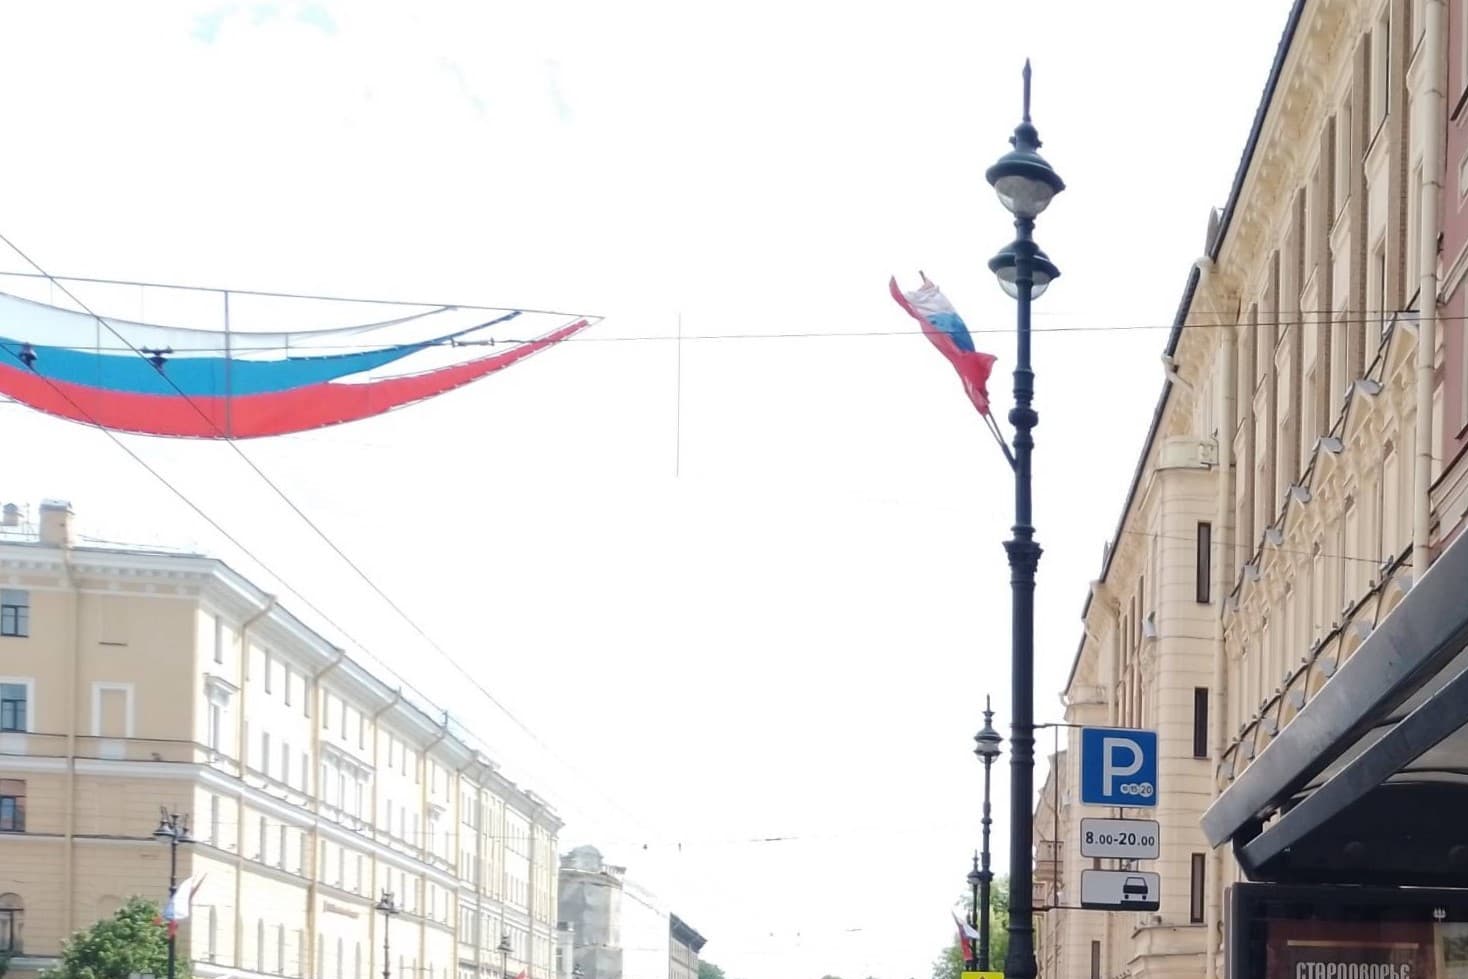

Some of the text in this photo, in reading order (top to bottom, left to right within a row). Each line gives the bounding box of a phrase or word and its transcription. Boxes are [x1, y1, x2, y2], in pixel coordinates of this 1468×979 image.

[1103, 737, 1144, 796] P
[1141, 785, 1152, 794] 20
[1085, 831, 1155, 846] 8.00-20.00
